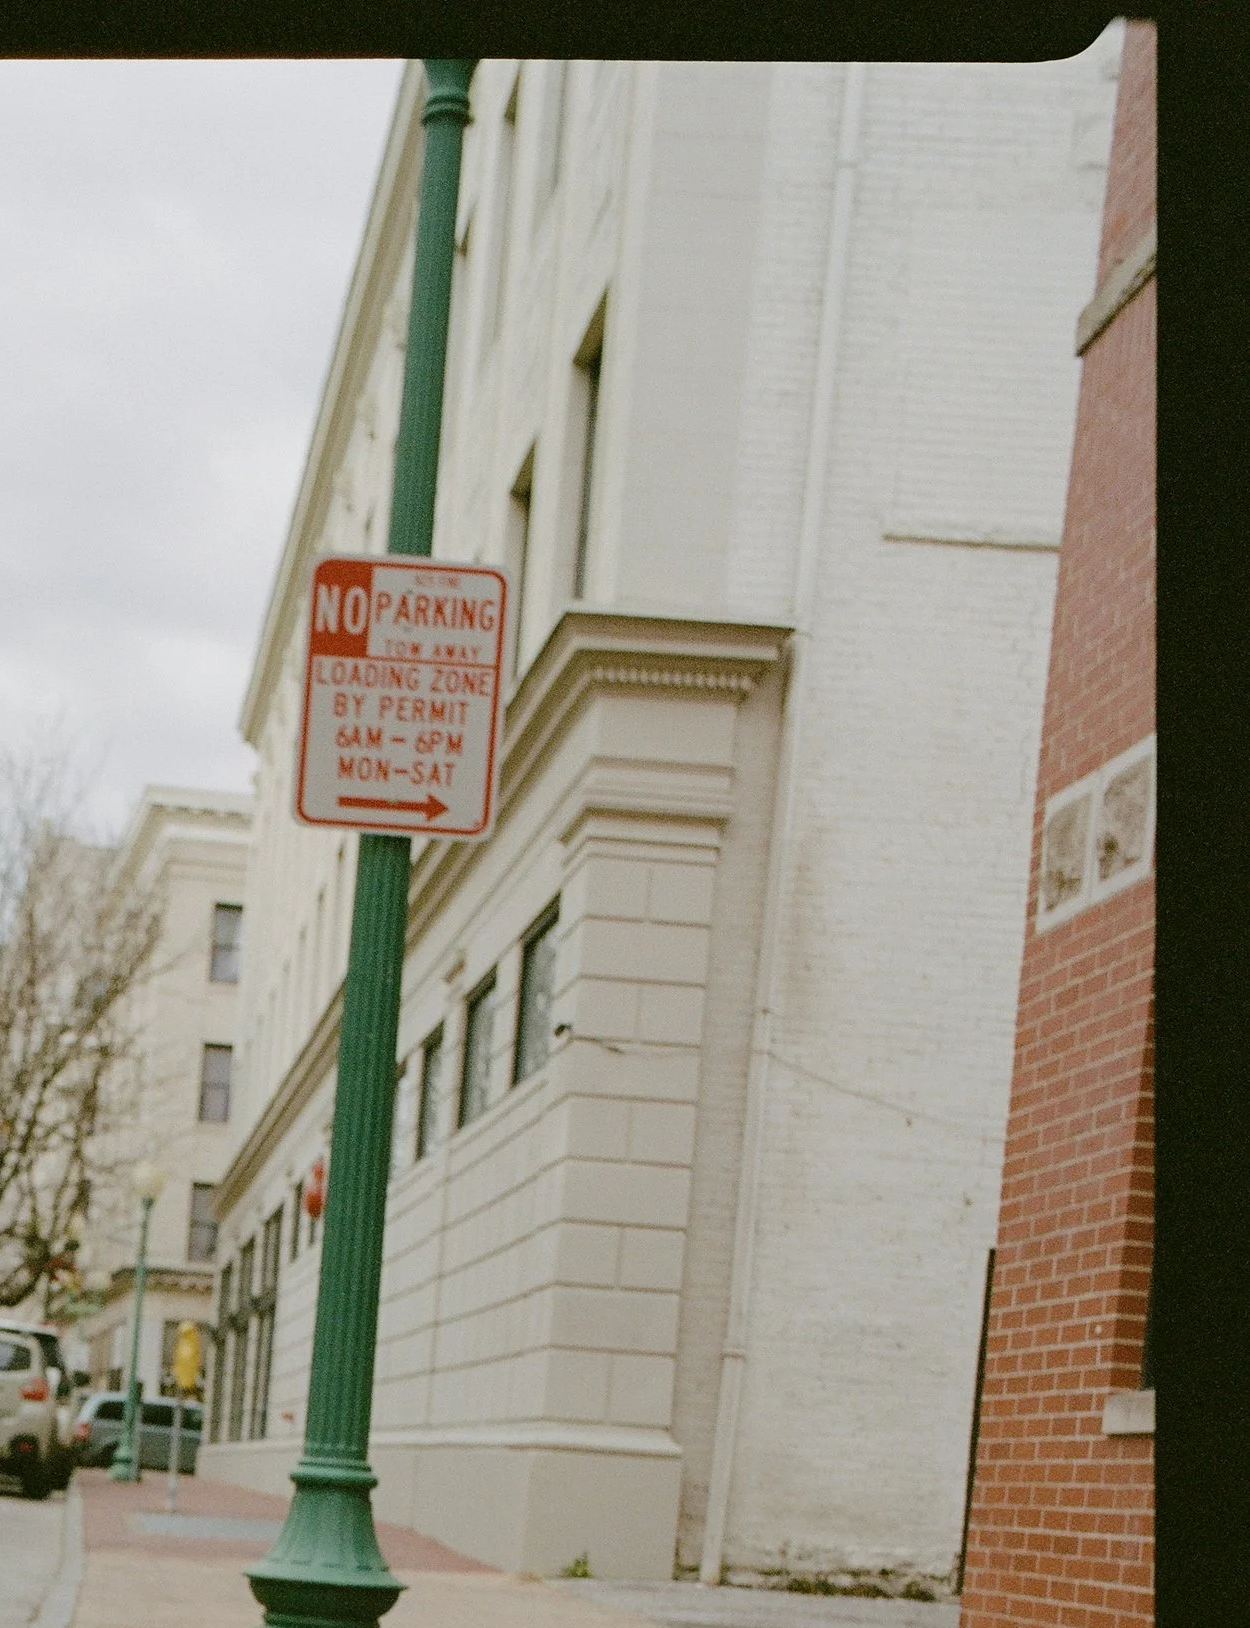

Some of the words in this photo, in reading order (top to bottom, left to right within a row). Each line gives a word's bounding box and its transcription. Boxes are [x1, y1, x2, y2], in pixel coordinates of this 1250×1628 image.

[315, 583, 370, 635] NO
[374, 591, 495, 633] PARKING
[431, 643, 482, 660] AWAY
[315, 660, 421, 692] LOADING
[429, 668, 493, 698] ZONE
[332, 691, 366, 718] BY
[377, 695, 469, 725] PERMIT
